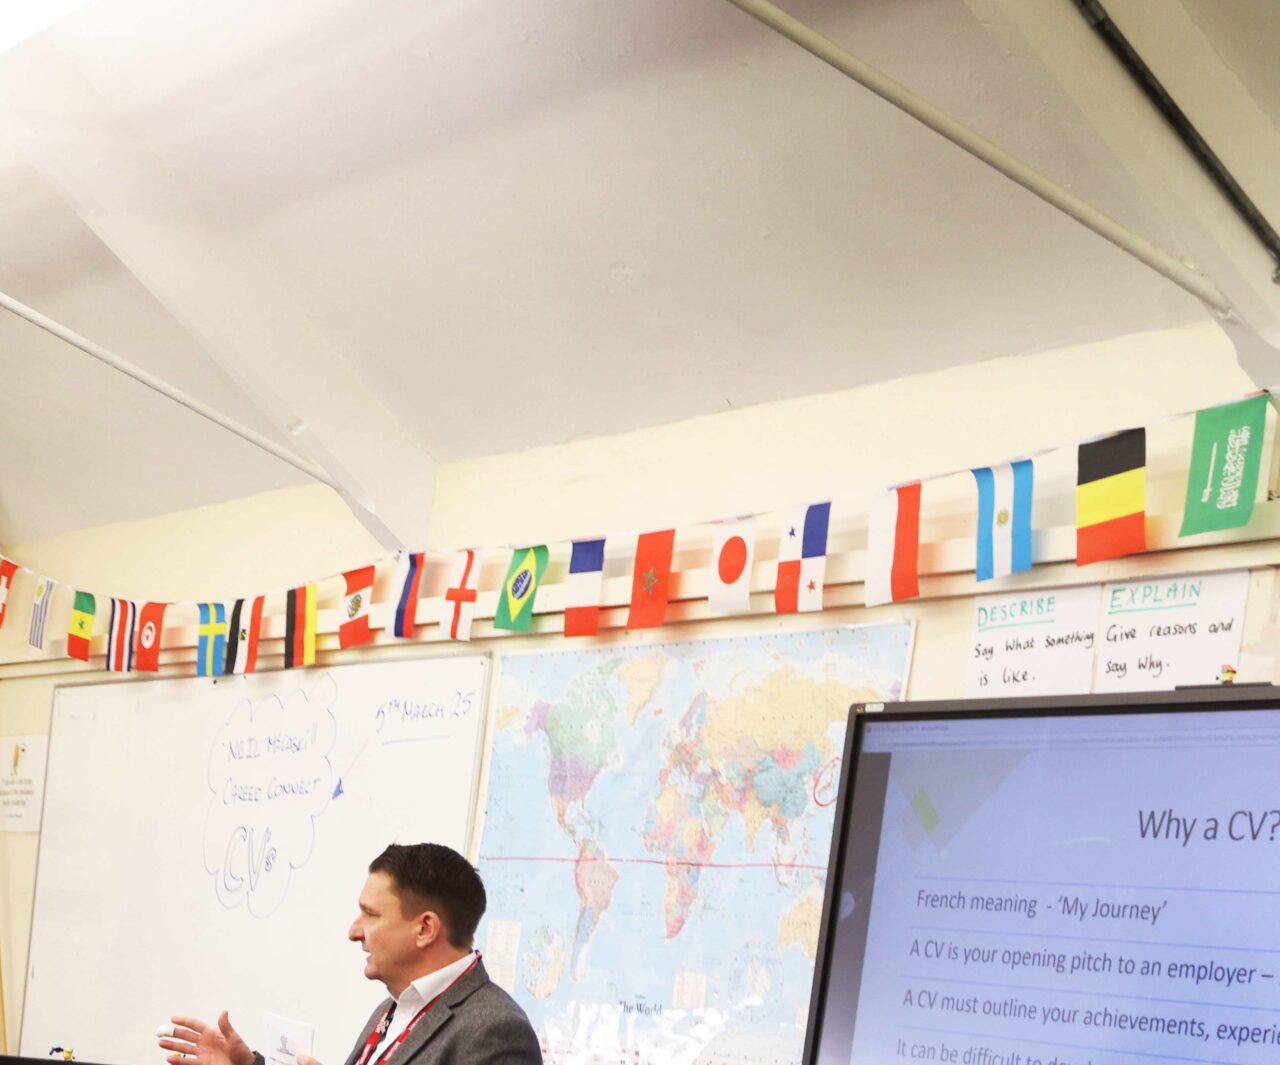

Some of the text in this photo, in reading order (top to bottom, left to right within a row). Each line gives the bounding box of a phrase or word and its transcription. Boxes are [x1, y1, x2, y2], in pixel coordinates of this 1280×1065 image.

[1110, 581, 1202, 609] EXPLAIN
[977, 596, 1056, 628] DESCRIBE
[1106, 617, 1234, 643] Give reasons and
[979, 671, 990, 687] is
[450, 690, 476, 721] 25
[1139, 809, 1280, 847] Why a CV?
[917, 889, 966, 911] French
[971, 895, 1037, 919] meaning
[909, 940, 921, 957] A
[924, 940, 945, 960] CV
[948, 942, 959, 960] is
[963, 949, 998, 966] your
[1002, 947, 1066, 974] opening
[1070, 951, 1112, 975] pitch
[1118, 955, 1135, 976] to
[1140, 960, 1162, 977] an
[1167, 960, 1256, 988] employer
[903, 989, 914, 1007] A
[917, 990, 938, 1010] CV
[941, 994, 978, 1014] must
[982, 998, 1037, 1020] outline
[1042, 1007, 1079, 1025] your
[1083, 1010, 1210, 1042] achievements,
[897, 1038, 907, 1056] It
[910, 1043, 936, 1060] can
[940, 1043, 959, 1063] be
